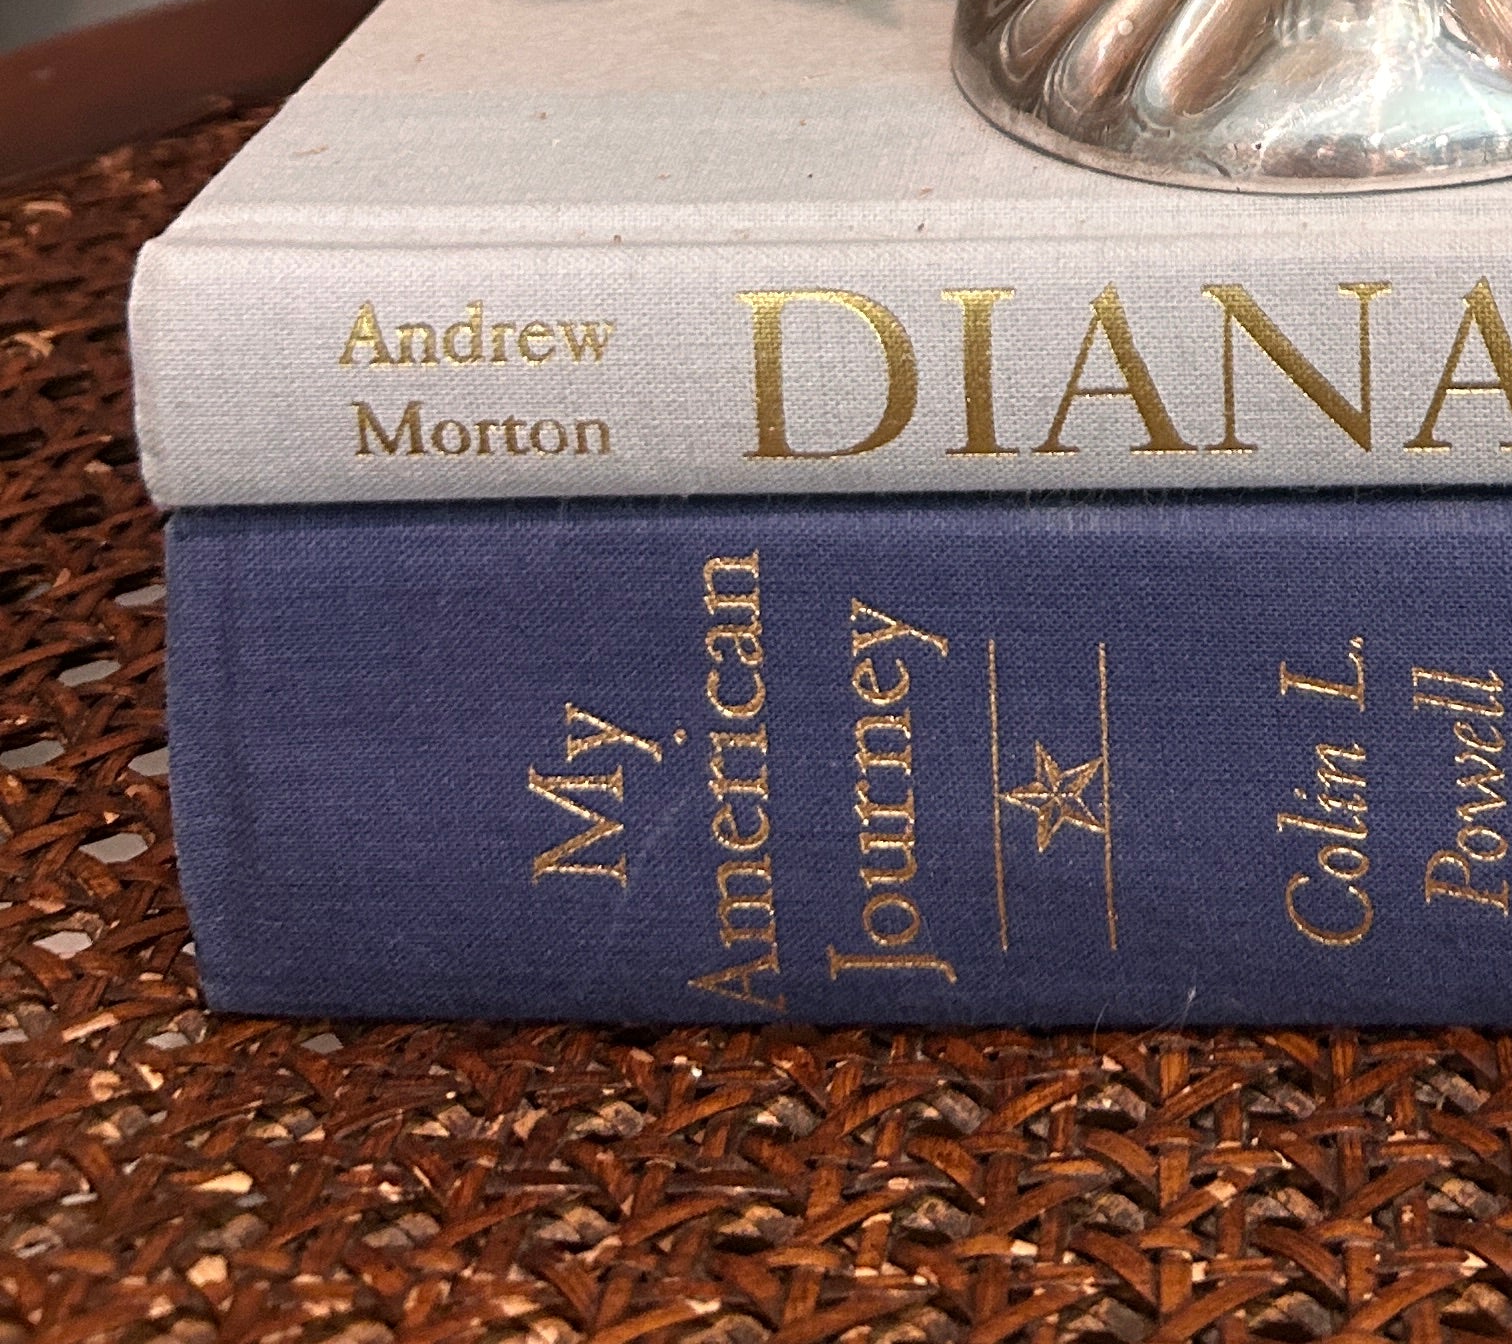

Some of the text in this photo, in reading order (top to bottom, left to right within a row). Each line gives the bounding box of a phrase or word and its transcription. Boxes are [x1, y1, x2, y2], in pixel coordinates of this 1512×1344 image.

[338, 300, 613, 369] Andrew
[353, 402, 613, 457] Morton
[528, 702, 662, 887] My
[673, 549, 787, 1012] American
[828, 597, 957, 983] Journey
[1277, 636, 1374, 946] Colin L.
[1412, 667, 1510, 915] Powell
